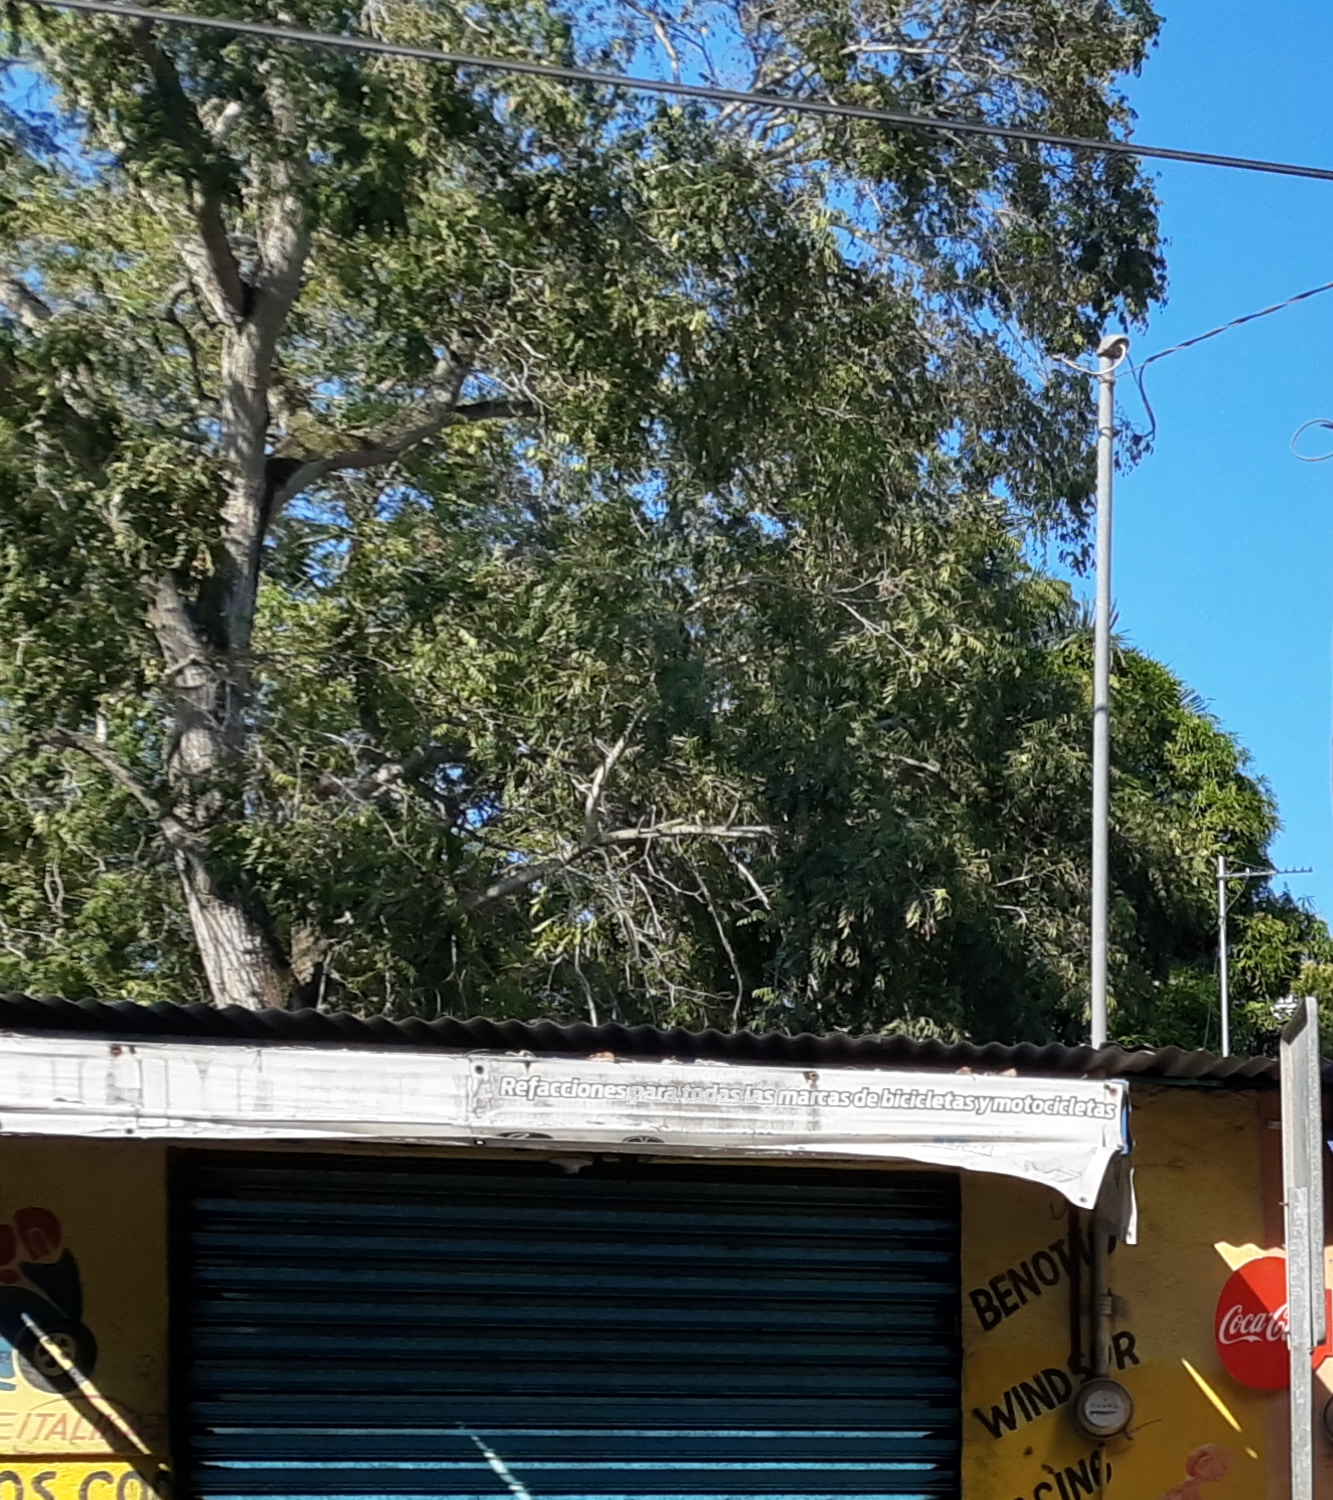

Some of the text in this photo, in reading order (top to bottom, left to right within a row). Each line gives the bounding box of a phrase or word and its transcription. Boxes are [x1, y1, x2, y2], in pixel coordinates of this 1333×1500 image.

[500, 1075, 1117, 1119] Refacciones para todas las marcas de bicicletas y motocicletas
[972, 1331, 1141, 1439] WINDR
